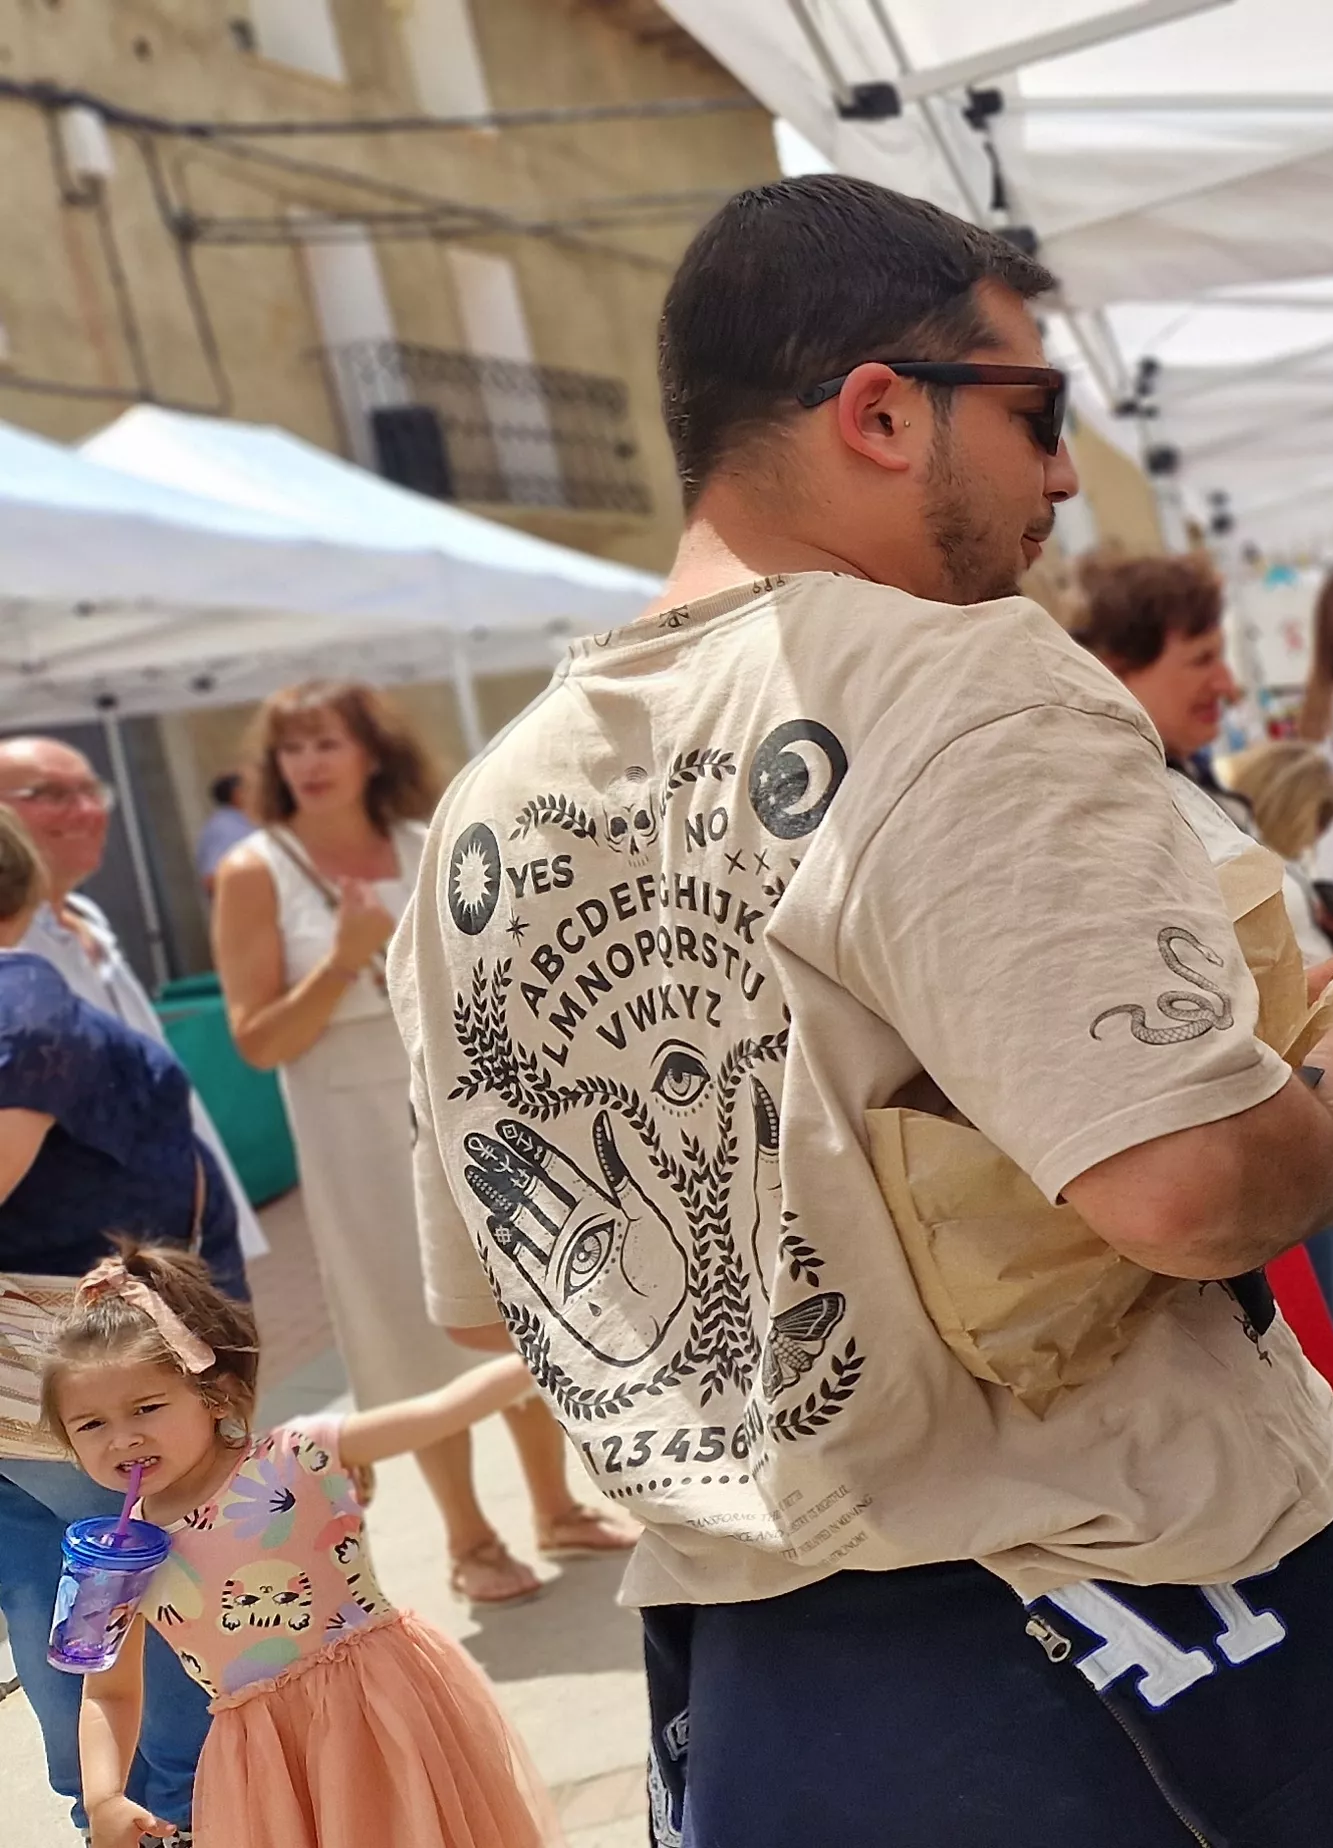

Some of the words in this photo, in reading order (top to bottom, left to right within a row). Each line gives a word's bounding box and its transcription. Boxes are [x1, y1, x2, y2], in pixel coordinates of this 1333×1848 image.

[684, 806, 728, 852] NO
[506, 854, 575, 898] YES
[541, 925, 766, 1067] LMNOPQRSTU
[596, 983, 722, 1051] VWXYZ
